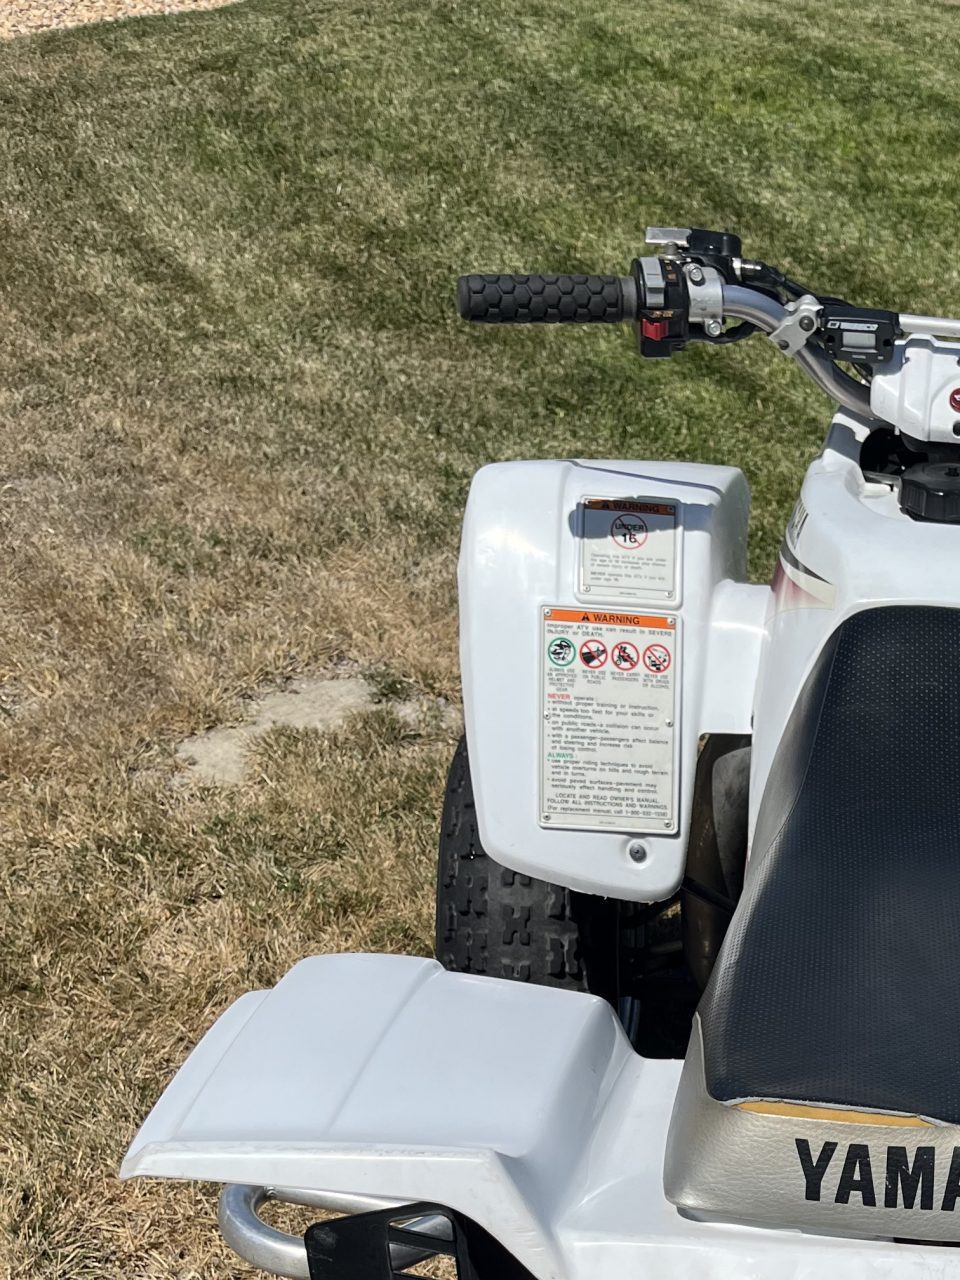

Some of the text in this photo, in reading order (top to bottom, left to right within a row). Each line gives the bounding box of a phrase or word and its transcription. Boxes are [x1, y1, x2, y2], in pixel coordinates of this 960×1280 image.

[613, 502, 659, 513] WARNING
[615, 523, 644, 531] UNDER
[622, 533, 637, 543] 16
[593, 614, 640, 625] WARNING
[560, 806, 590, 814] replacement
